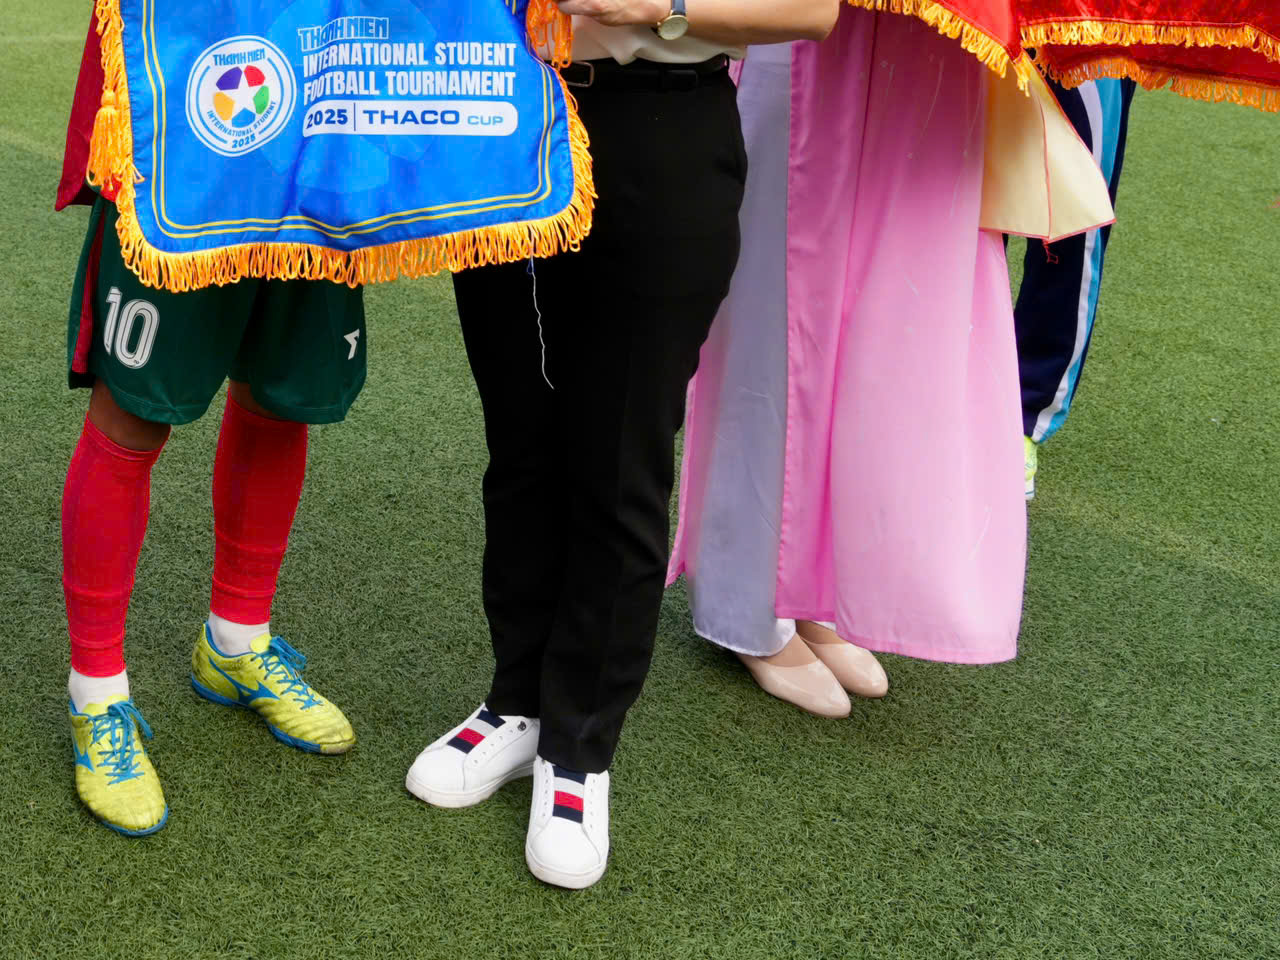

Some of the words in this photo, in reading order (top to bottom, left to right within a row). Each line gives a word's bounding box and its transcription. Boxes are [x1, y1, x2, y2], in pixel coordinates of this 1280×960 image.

[303, 42, 430, 78] INTERNATIONAL
[434, 41, 517, 67] STUDENT
[303, 70, 380, 107] FOOTBALL
[384, 70, 516, 97] TOURNAMENT
[206, 109, 253, 138] INTERNATIONAL
[253, 100, 277, 130] STUDENT
[306, 108, 349, 130] 2025
[362, 109, 460, 125] THACO
[467, 115, 504, 126] CUP
[231, 133, 257, 148] 2025
[103, 286, 160, 369] 10
